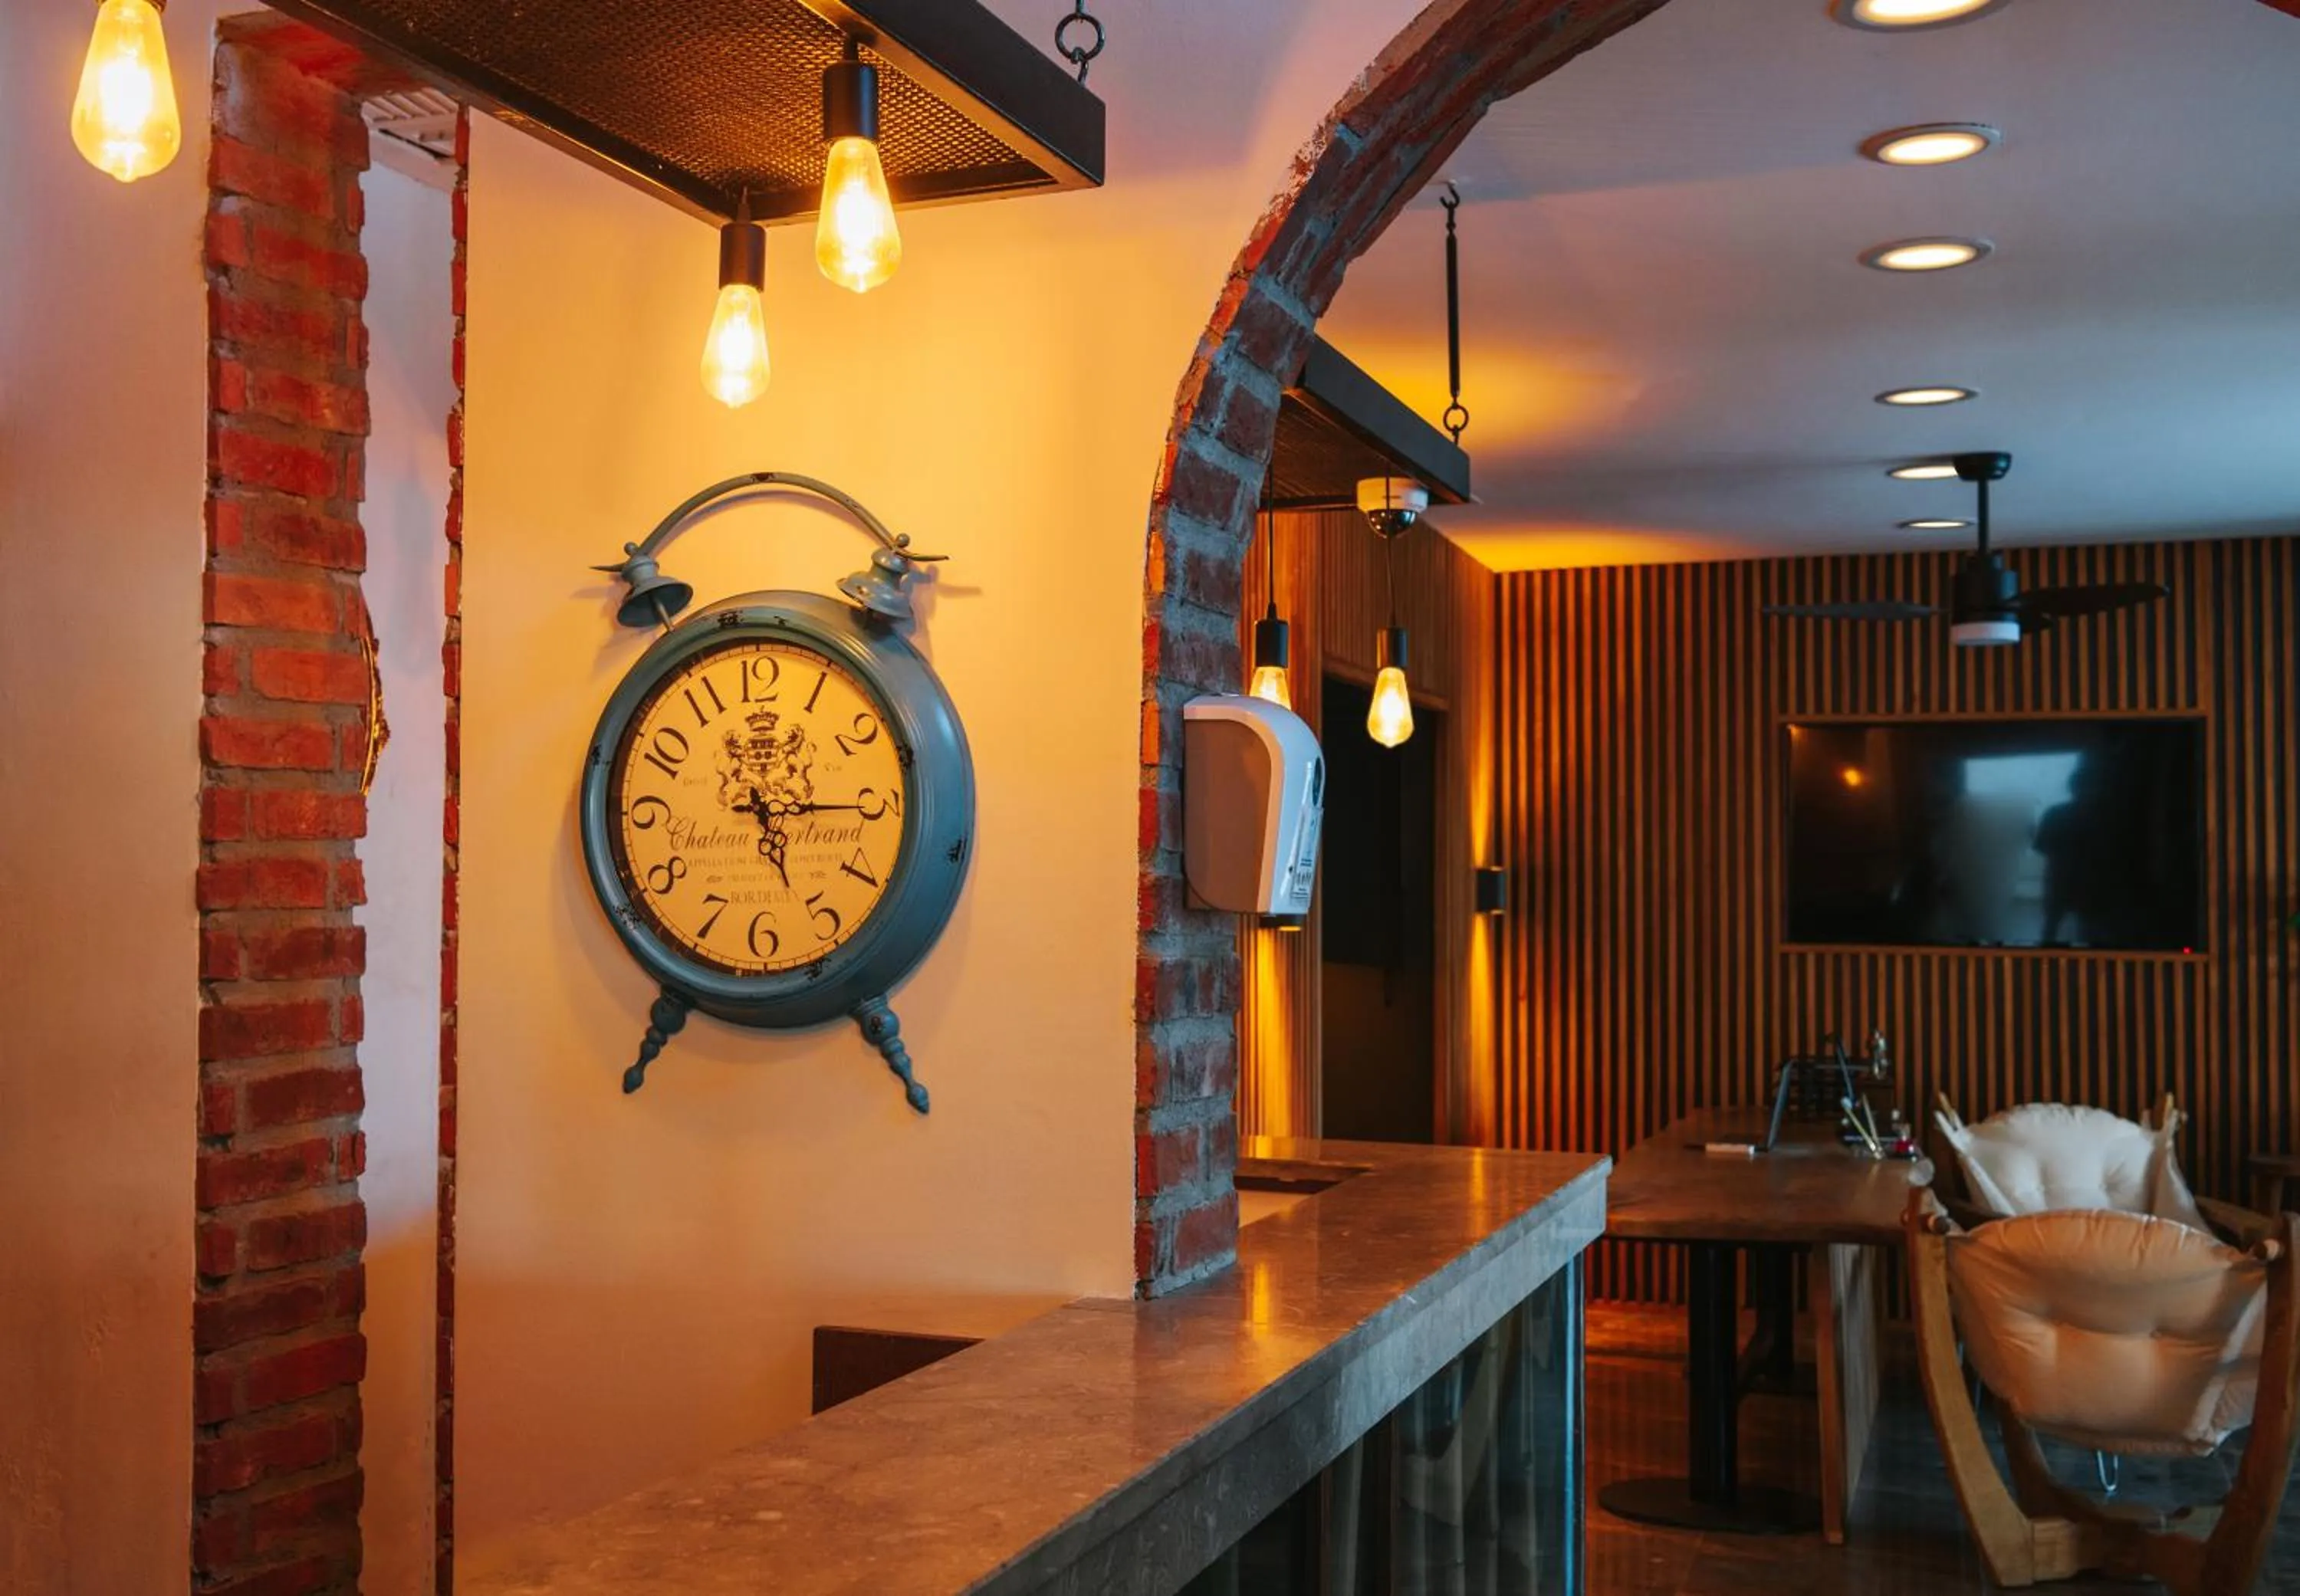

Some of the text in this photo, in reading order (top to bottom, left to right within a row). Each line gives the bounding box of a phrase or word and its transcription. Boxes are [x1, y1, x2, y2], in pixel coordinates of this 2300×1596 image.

[684, 675, 728, 727] 11
[741, 657, 779, 703] 12
[804, 672, 827, 714] 1
[644, 727, 689, 780] 10
[834, 713, 879, 756] 2
[631, 795, 672, 829] 9
[858, 787, 900, 821] 3
[768, 814, 864, 847] ertrand
[648, 856, 687, 895] 8
[840, 847, 879, 888] 4
[697, 894, 728, 939] 7
[748, 911, 778, 957] 6
[806, 891, 841, 941] 5
